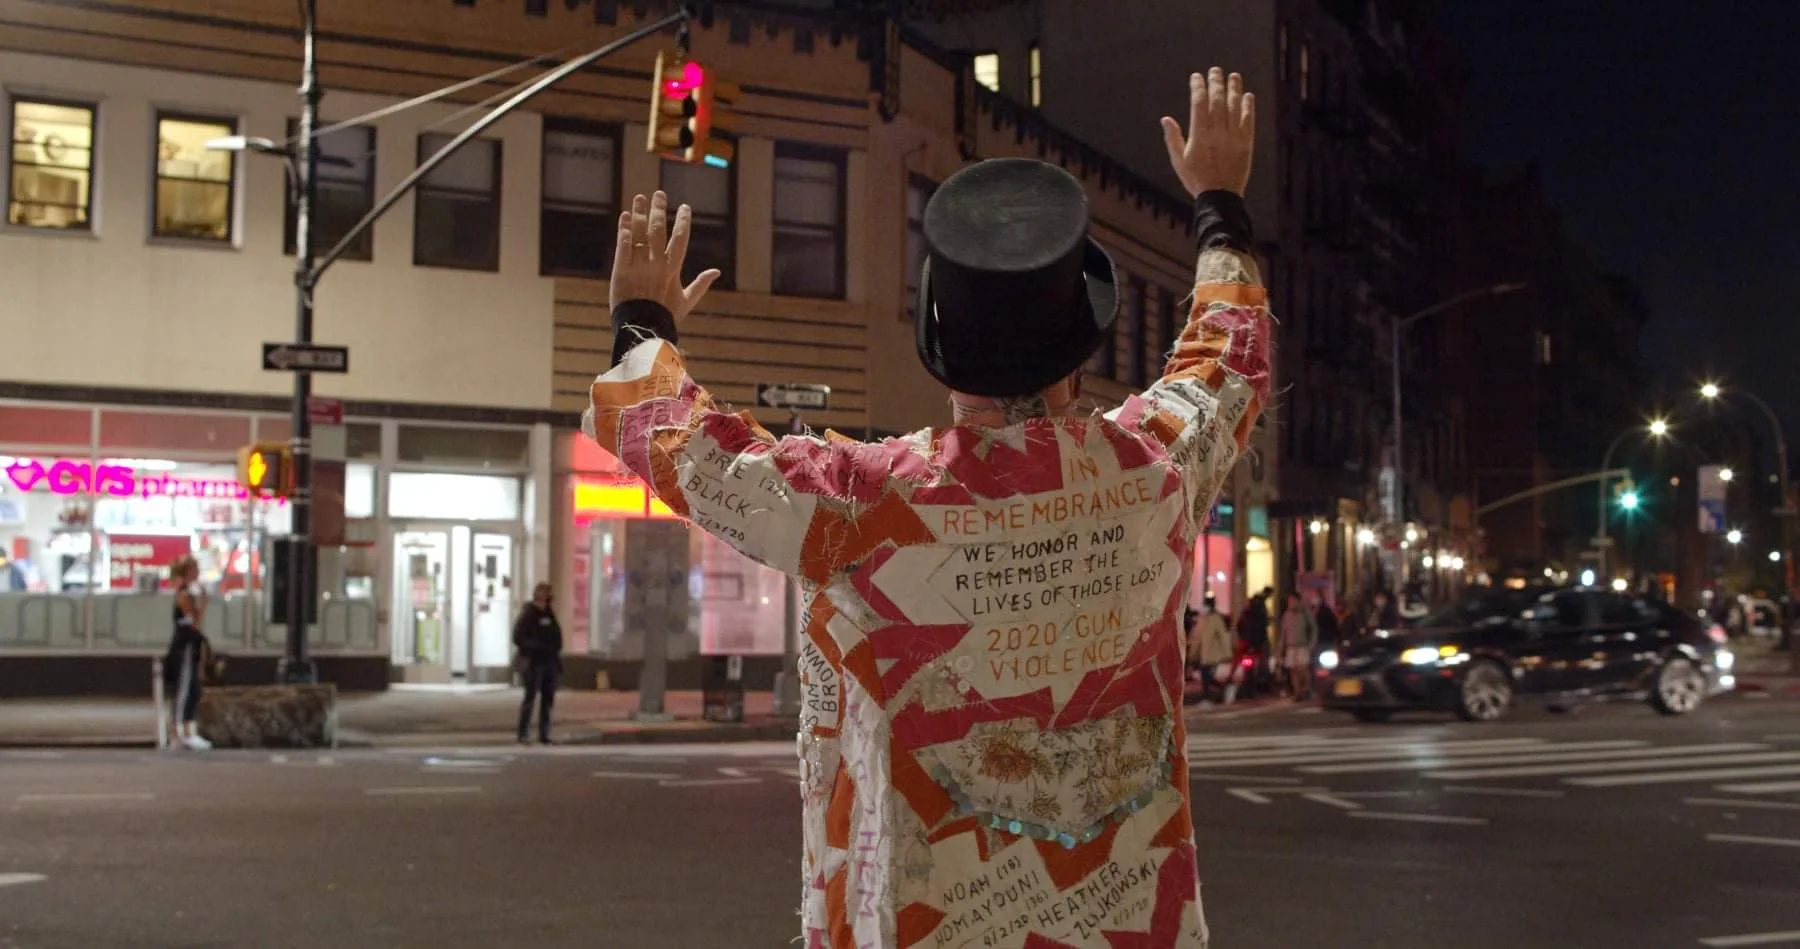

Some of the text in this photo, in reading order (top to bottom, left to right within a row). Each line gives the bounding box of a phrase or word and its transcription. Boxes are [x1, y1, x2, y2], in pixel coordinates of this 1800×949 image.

[49, 459, 136, 497] CVS
[1069, 456, 1099, 482] IN
[685, 474, 752, 518] BLACK
[943, 477, 1151, 536] REMEMBRANCE
[963, 524, 1125, 563] WE HONOR AND
[955, 550, 1119, 591] REMEMBER THE
[972, 560, 1165, 616] LIVES OF THOSE LOST
[985, 607, 1123, 652] 2020 GUN
[802, 642, 838, 713] BROWN
[989, 634, 1126, 682] VIOLENCE
[805, 683, 820, 726] SAM
[935, 869, 1040, 947] HOMAYOUNI
[943, 873, 991, 906] NOAH
[1037, 861, 1122, 928] HEATHER
